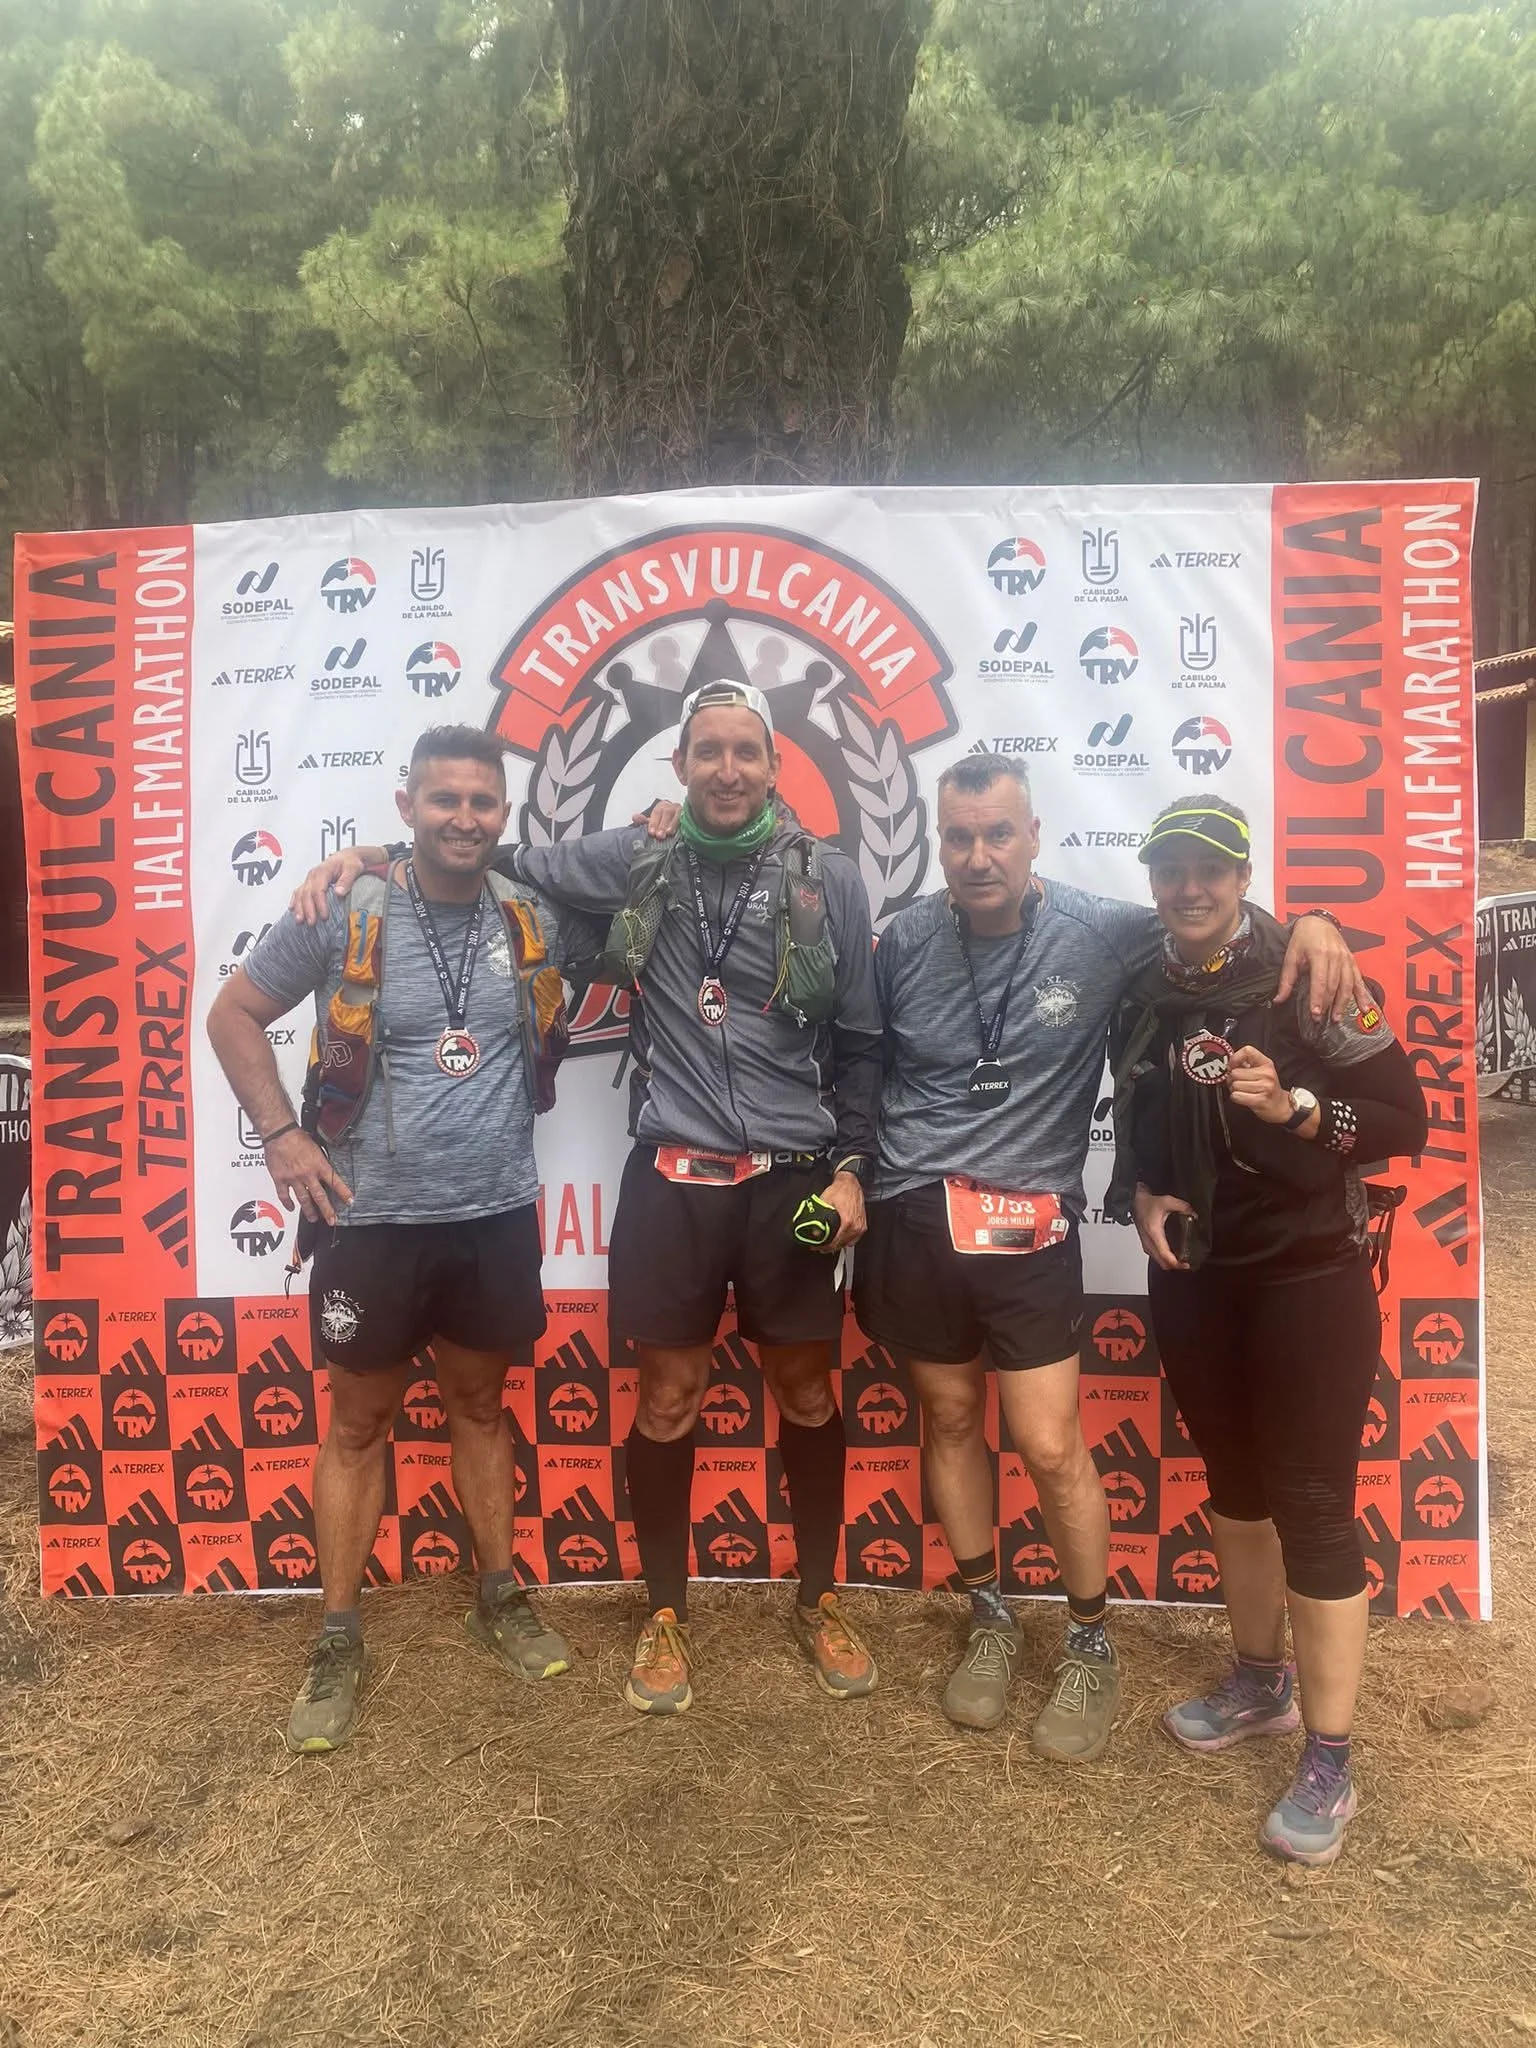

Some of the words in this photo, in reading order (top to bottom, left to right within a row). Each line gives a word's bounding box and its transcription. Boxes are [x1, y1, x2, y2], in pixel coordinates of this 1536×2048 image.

[1174, 551, 1242, 568] TERREX
[987, 568, 1046, 596] TRV
[321, 588, 376, 614] TRV
[1083, 588, 1119, 596] CABILDO
[222, 598, 294, 614] SODEPAL
[410, 604, 444, 612] CABILDO
[519, 546, 918, 690] TRANSVULCANIA
[1402, 503, 1462, 765] MARATHON
[133, 545, 188, 793] MARATHON
[234, 665, 296, 684] TERREX
[979, 660, 1054, 673] SODEPAL
[1080, 658, 1138, 685] TRV
[310, 676, 382, 691] SODEPAL
[406, 671, 461, 698] TRV
[992, 737, 1058, 755] TERREX
[321, 750, 385, 768] TERREX
[1073, 753, 1149, 766] SODEPAL
[1172, 747, 1232, 775] TRV
[236, 788, 272, 796] CABILDO
[1404, 771, 1464, 888] HALF
[1084, 831, 1151, 848] TERREX
[133, 801, 184, 911] HALF
[232, 860, 283, 887] TRV
[737, 882, 751, 898] 2024
[29, 551, 124, 1272] TRANSVULCANIA
[1405, 915, 1467, 1168] TERREX
[136, 937, 188, 1177] TERREX
[981, 1082, 1009, 1090] TERREX
[987, 1216, 1008, 1225] JORGE
[230, 1231, 284, 1258] TRV
[119, 1311, 157, 1322] TERREX
[257, 1307, 299, 1320] TERREX
[556, 1302, 599, 1313] TERREX
[44, 1339, 88, 1361] TRV
[177, 1338, 223, 1361] TRV
[1092, 1338, 1146, 1361] TRV
[1413, 1341, 1464, 1364] TRV
[56, 1387, 93, 1398] TERREX
[188, 1386, 229, 1398] TERREX
[1103, 1389, 1149, 1401] TERREX
[1423, 1392, 1467, 1403] TERREX
[113, 1416, 156, 1438] TRV
[255, 1415, 303, 1436] TRV
[549, 1409, 599, 1432] TRV
[700, 1411, 750, 1434] TRV
[857, 1411, 907, 1433] TRV
[124, 1463, 165, 1474] TERREX
[266, 1457, 310, 1471] TERREX
[559, 1458, 602, 1469] TERREX
[713, 1461, 756, 1471] TERREX
[866, 1459, 910, 1471] TERREX
[1355, 1475, 1391, 1486] ERREX
[50, 1491, 90, 1513] TRV
[187, 1490, 234, 1511] TRV
[1415, 1505, 1464, 1528] TRV
[63, 1537, 101, 1549] TERREX
[201, 1533, 243, 1546] TERREX
[1108, 1543, 1148, 1554] ERREX
[708, 1550, 757, 1567] TRV
[1423, 1554, 1467, 1565] TERREX
[123, 1565, 171, 1584] TRV
[860, 1561, 910, 1577] TRV
[1172, 1573, 1220, 1592] TRV
